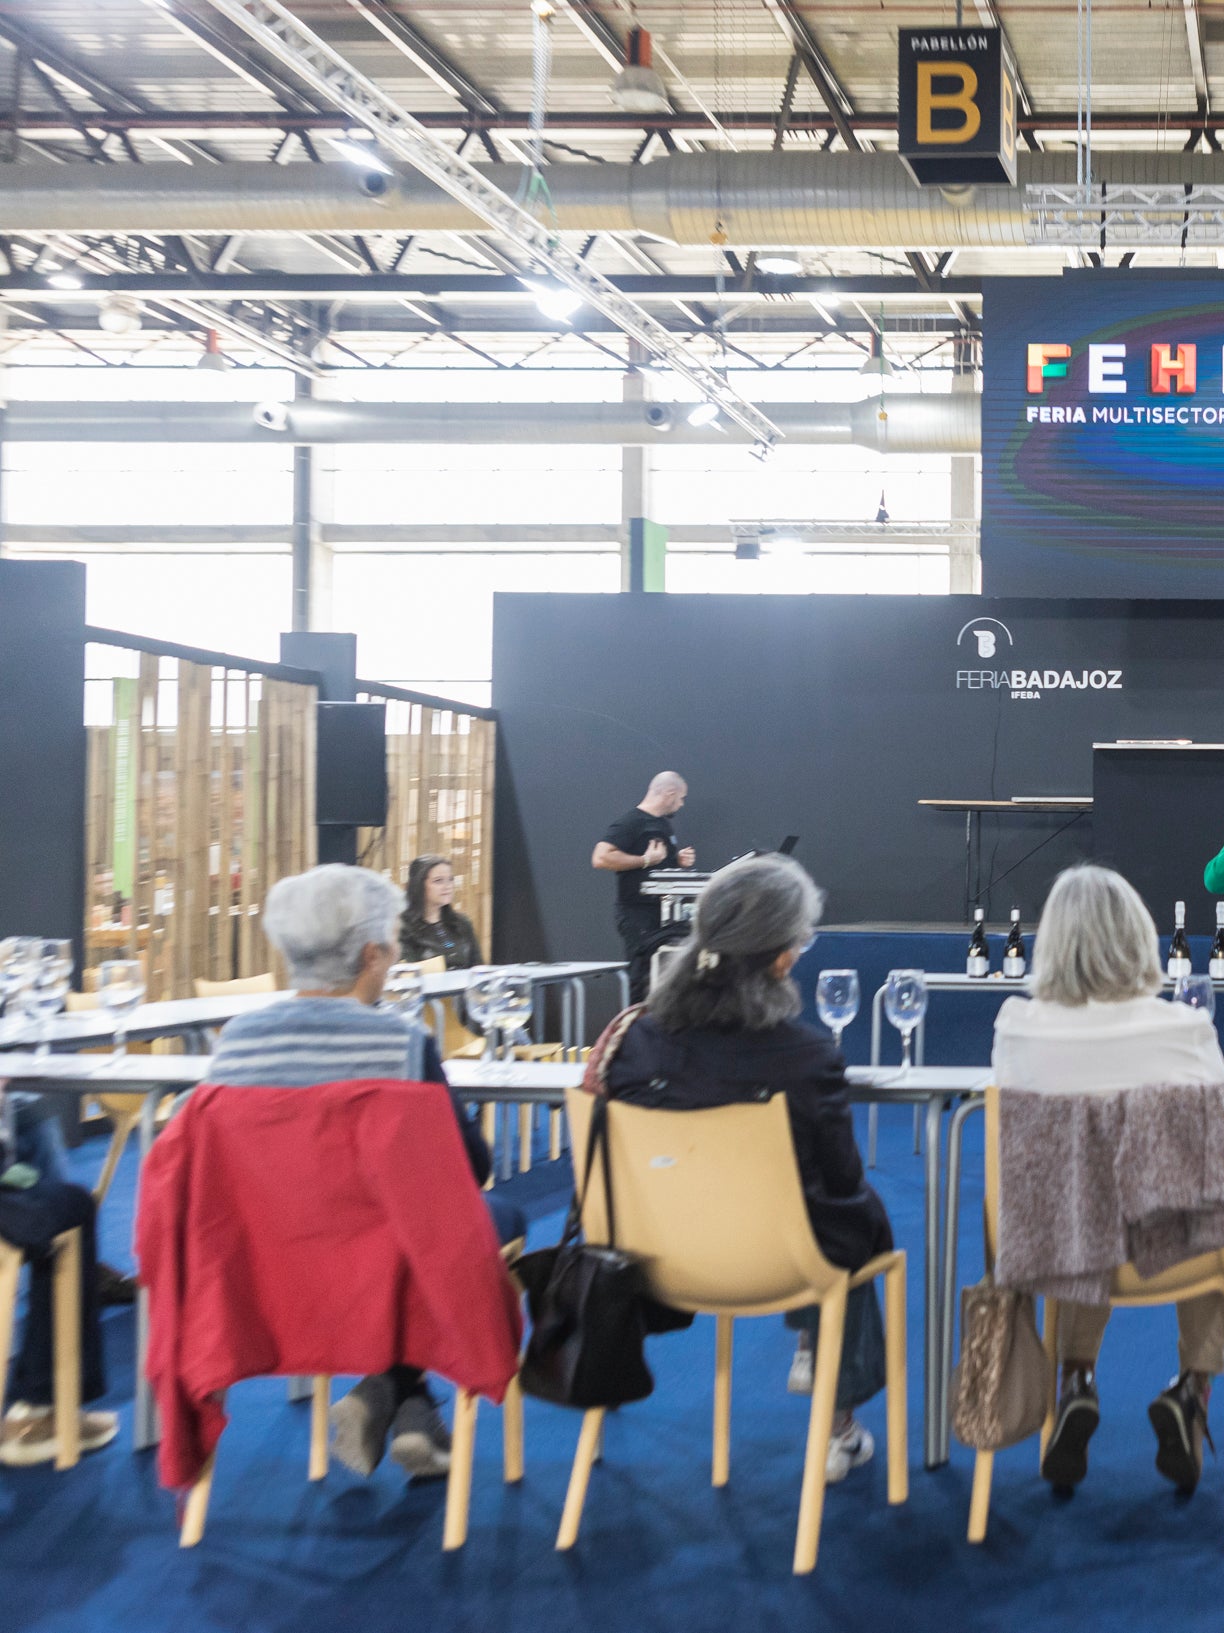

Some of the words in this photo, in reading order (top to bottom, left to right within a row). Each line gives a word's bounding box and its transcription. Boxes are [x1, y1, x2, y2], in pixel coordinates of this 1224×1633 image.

[917, 61, 981, 144] B
[1027, 407, 1086, 424] FERIA
[1011, 691, 1041, 699] IFEBA
